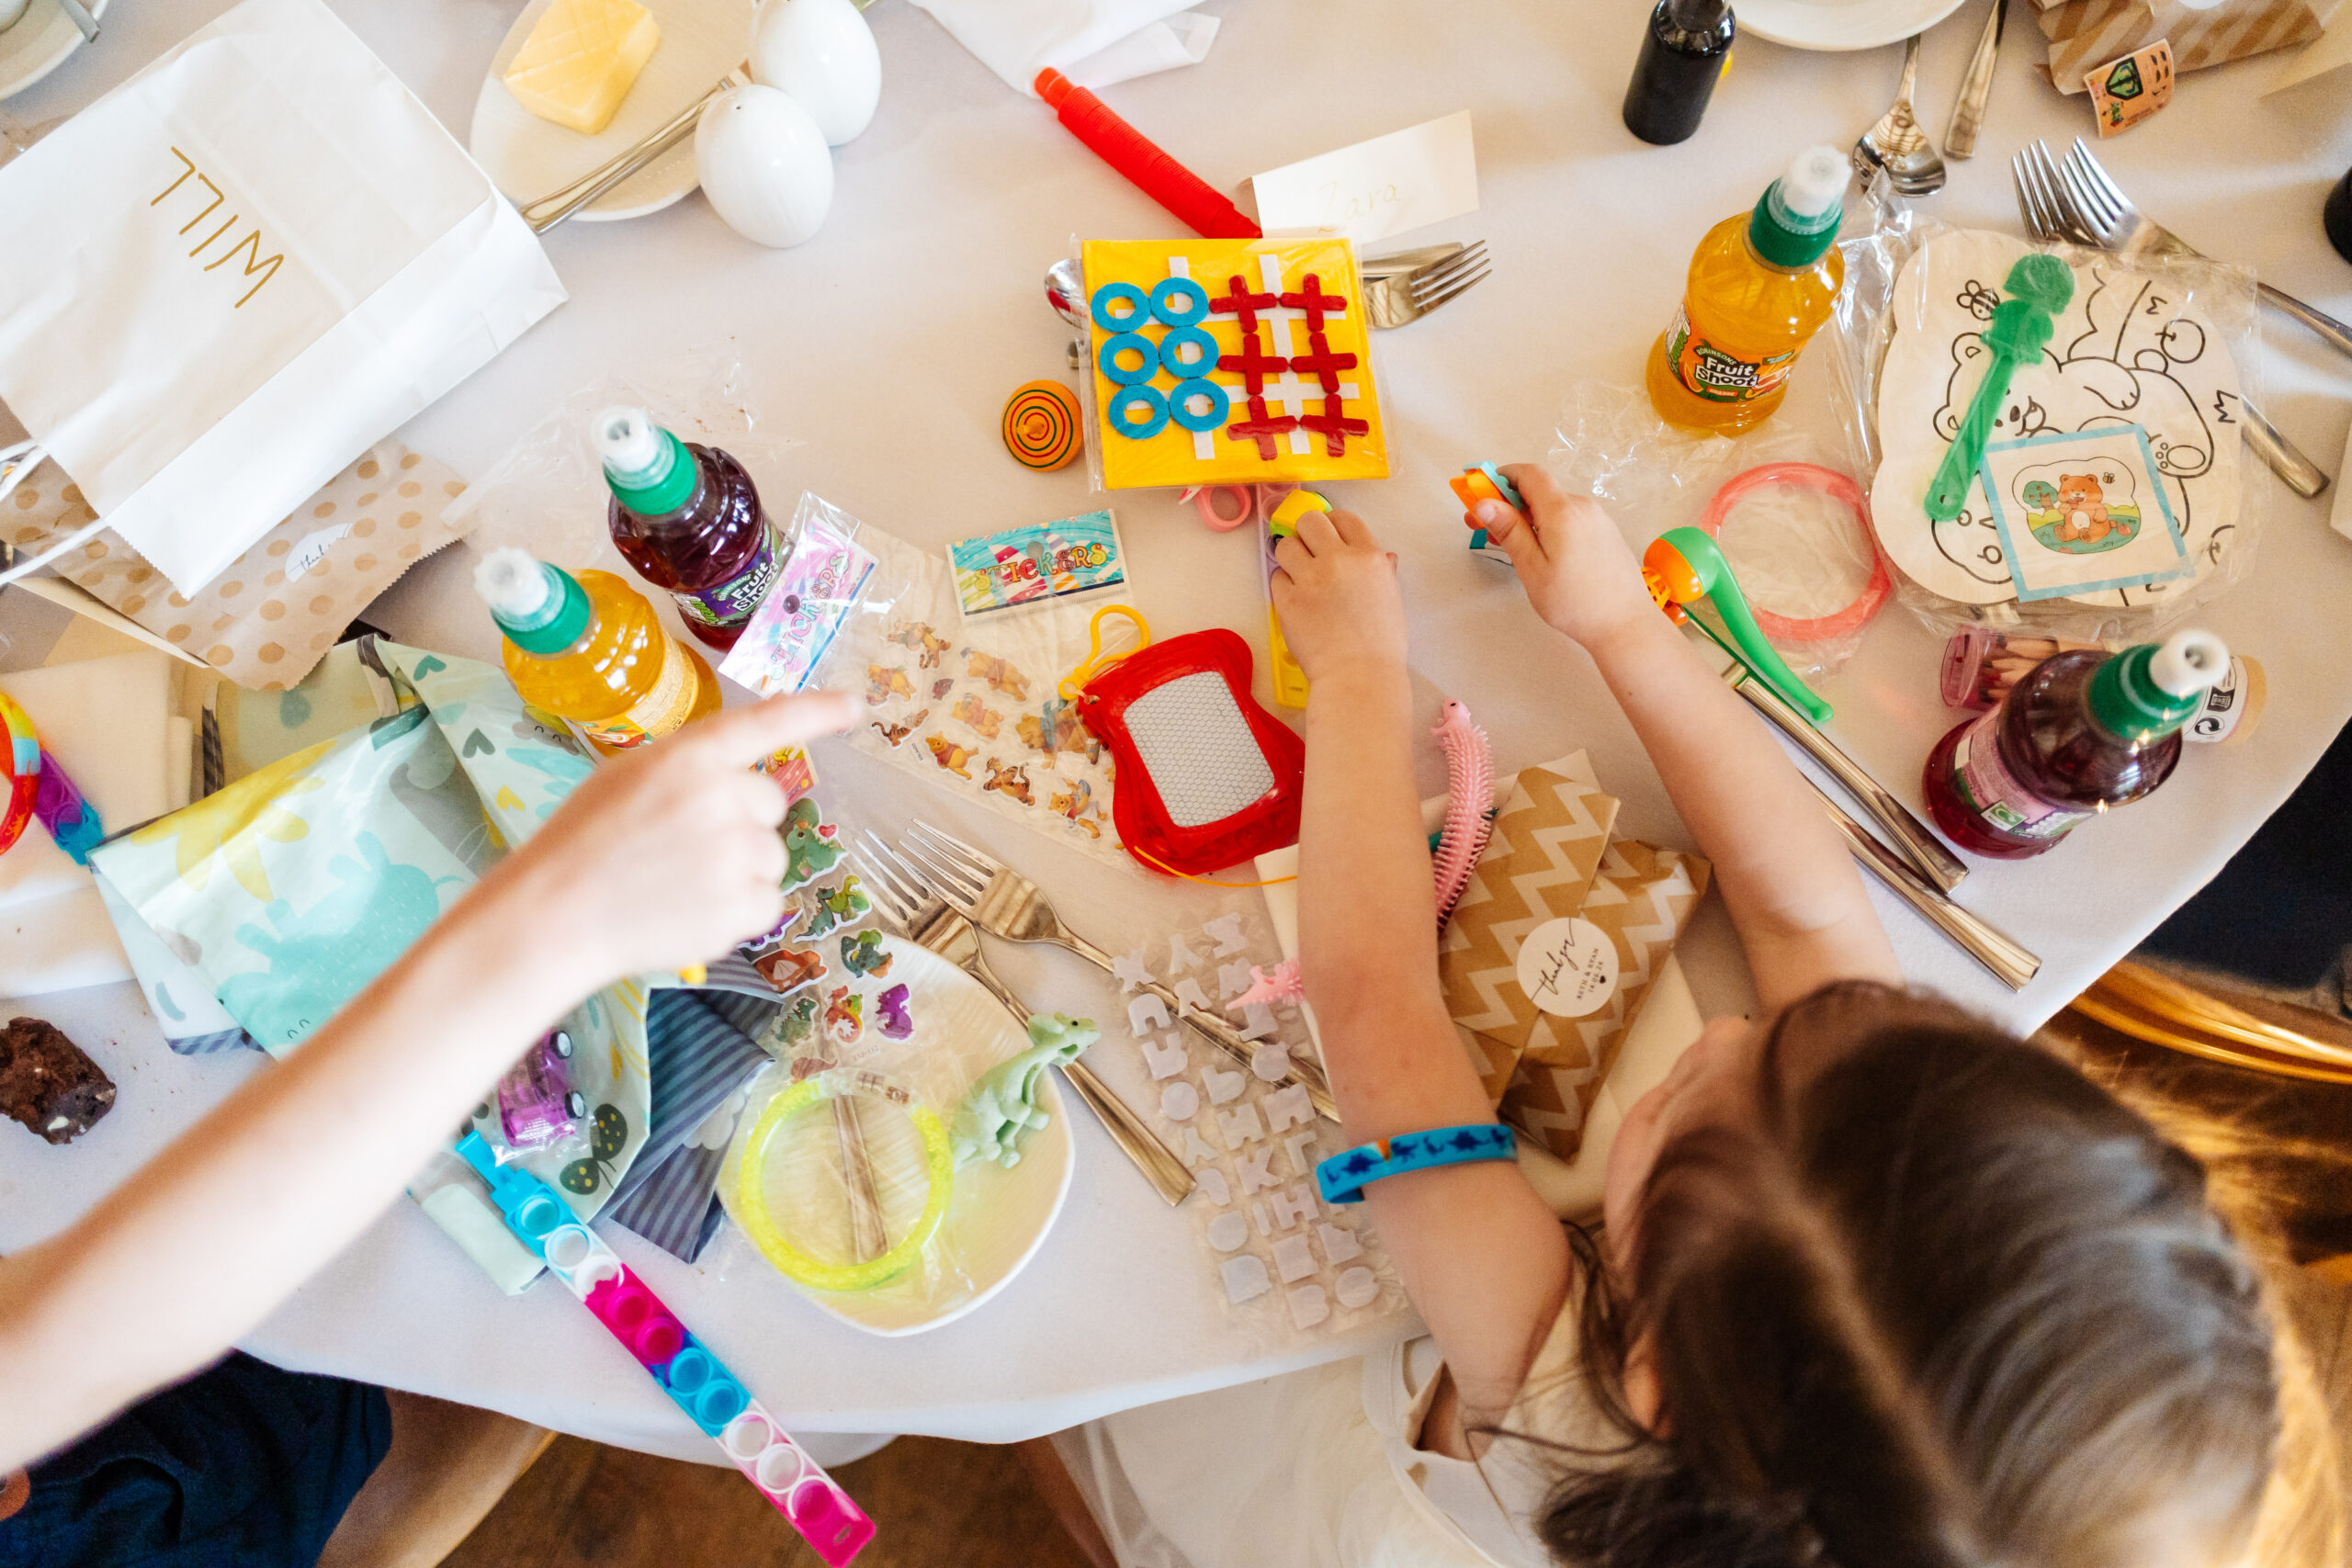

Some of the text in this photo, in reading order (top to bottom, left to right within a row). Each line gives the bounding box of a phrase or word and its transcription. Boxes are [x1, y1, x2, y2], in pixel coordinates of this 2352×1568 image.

[149, 145, 285, 310] WILL
[1317, 179, 1402, 233] Zara
[1696, 348, 1736, 365] ROBINSONS
[1697, 368, 1755, 386] Shoot
[1706, 356, 1753, 376] Fruit
[730, 561, 769, 600] Fruit
[737, 564, 778, 610] Shoot
[975, 544, 1107, 591] STICKERS
[1532, 951, 1564, 1002] thank
